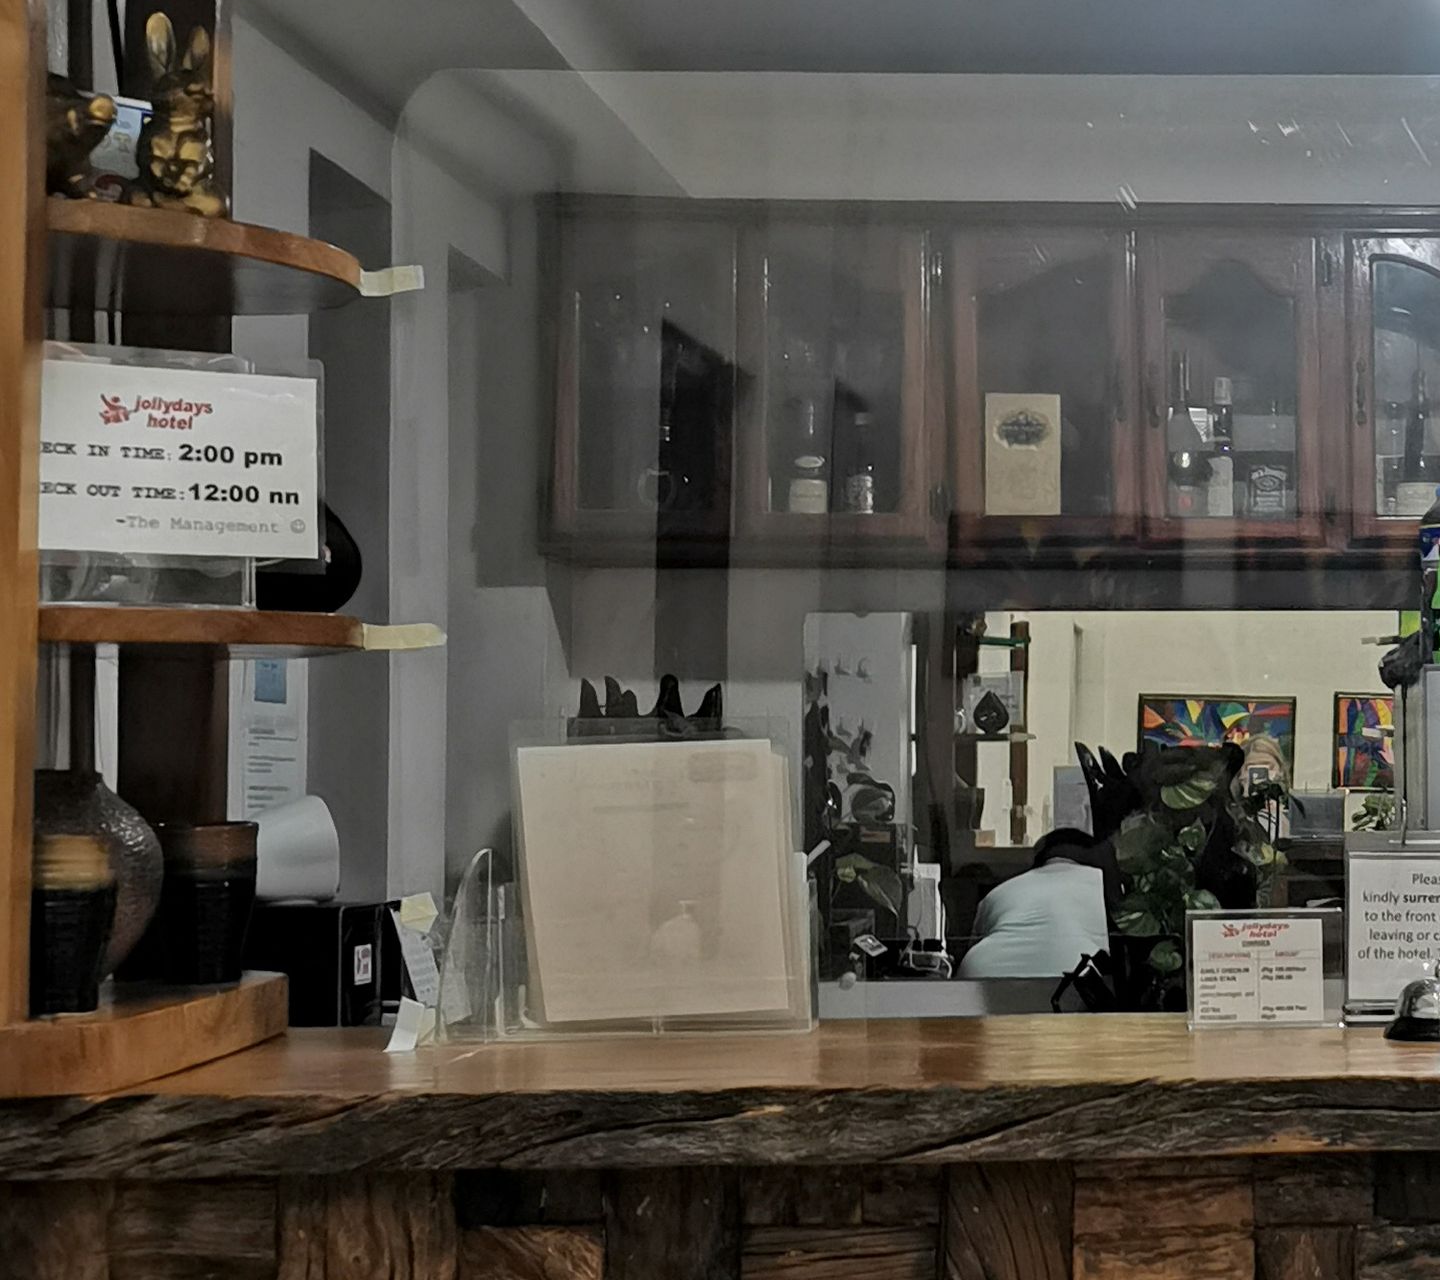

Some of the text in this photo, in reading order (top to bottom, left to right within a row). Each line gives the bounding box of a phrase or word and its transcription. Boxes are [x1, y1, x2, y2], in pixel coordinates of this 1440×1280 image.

[135, 395, 213, 416] jollydays
[147, 414, 193, 430] hotel
[41, 441, 282, 468] ECK IN TIME: 2:00 pm
[41, 482, 77, 495] ECK
[86, 484, 121, 497] OUT
[188, 483, 260, 503] 12:00
[269, 491, 299, 505] nn
[170, 517, 280, 534] Management
[1363, 890, 1400, 905] kindly
[1364, 911, 1378, 921] to
[1381, 909, 1402, 922] the
[1405, 909, 1436, 922] front
[1369, 928, 1414, 943] leaving
[1416, 931, 1431, 940] or
[1357, 946, 1371, 959] of
[1374, 946, 1395, 960] the
[1398, 945, 1433, 960] hotel.
